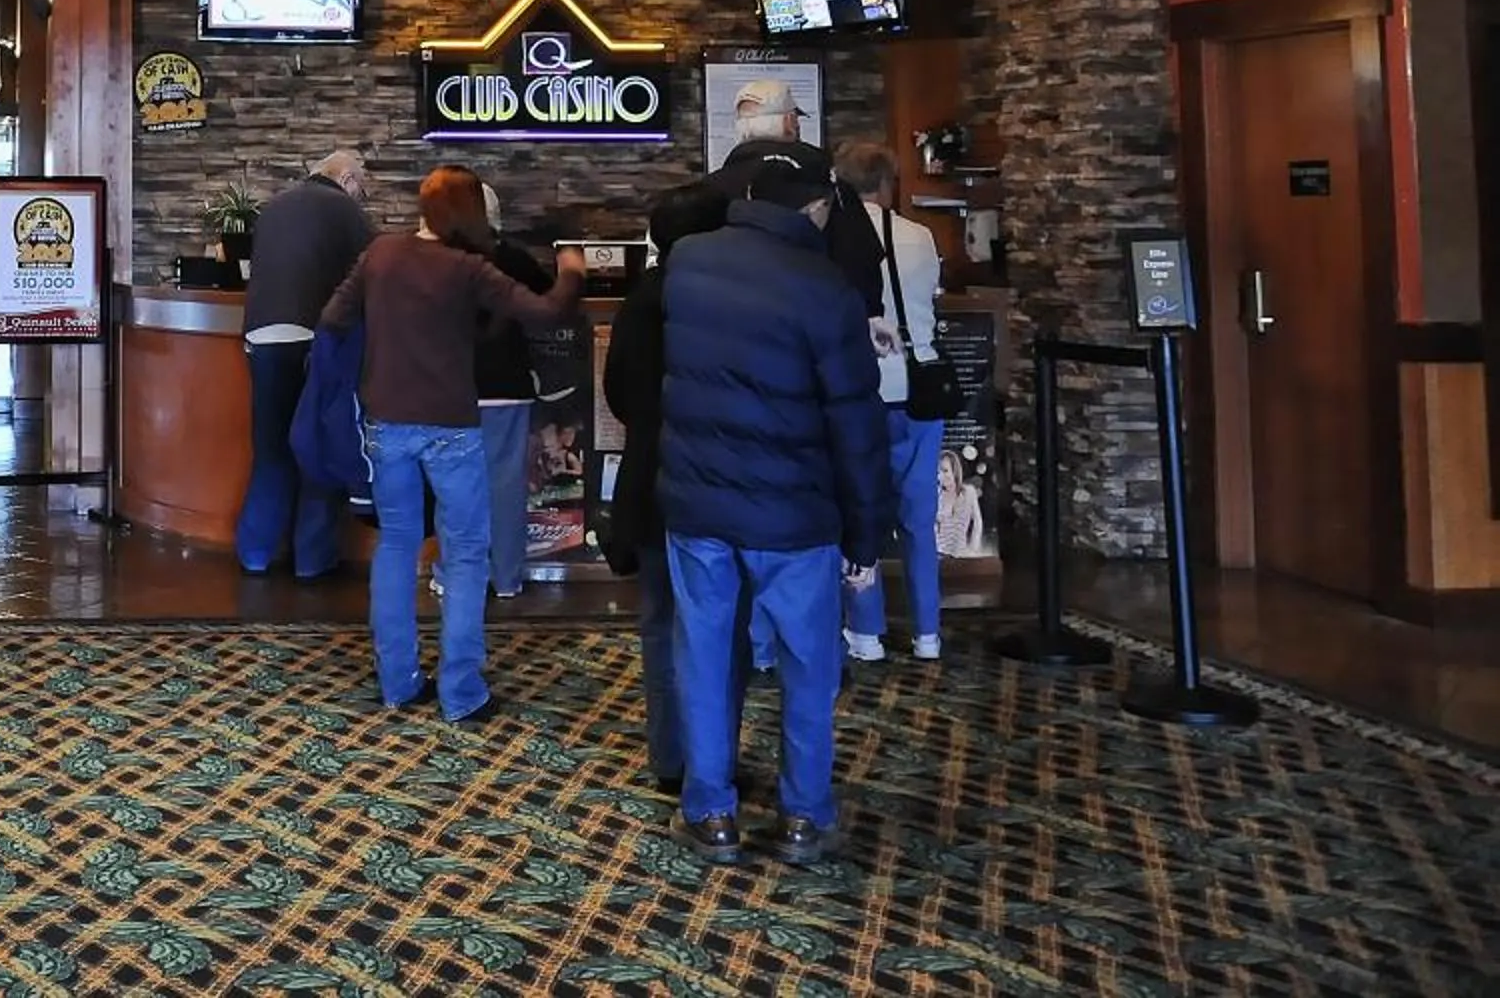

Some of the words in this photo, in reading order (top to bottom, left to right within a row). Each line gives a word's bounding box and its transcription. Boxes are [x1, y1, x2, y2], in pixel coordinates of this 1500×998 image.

[528, 36, 594, 70] Q
[435, 75, 519, 122] CLUB
[524, 75, 660, 123] CASINO
[13, 277, 75, 290] $10,000
[11, 316, 61, 327] Quinault
